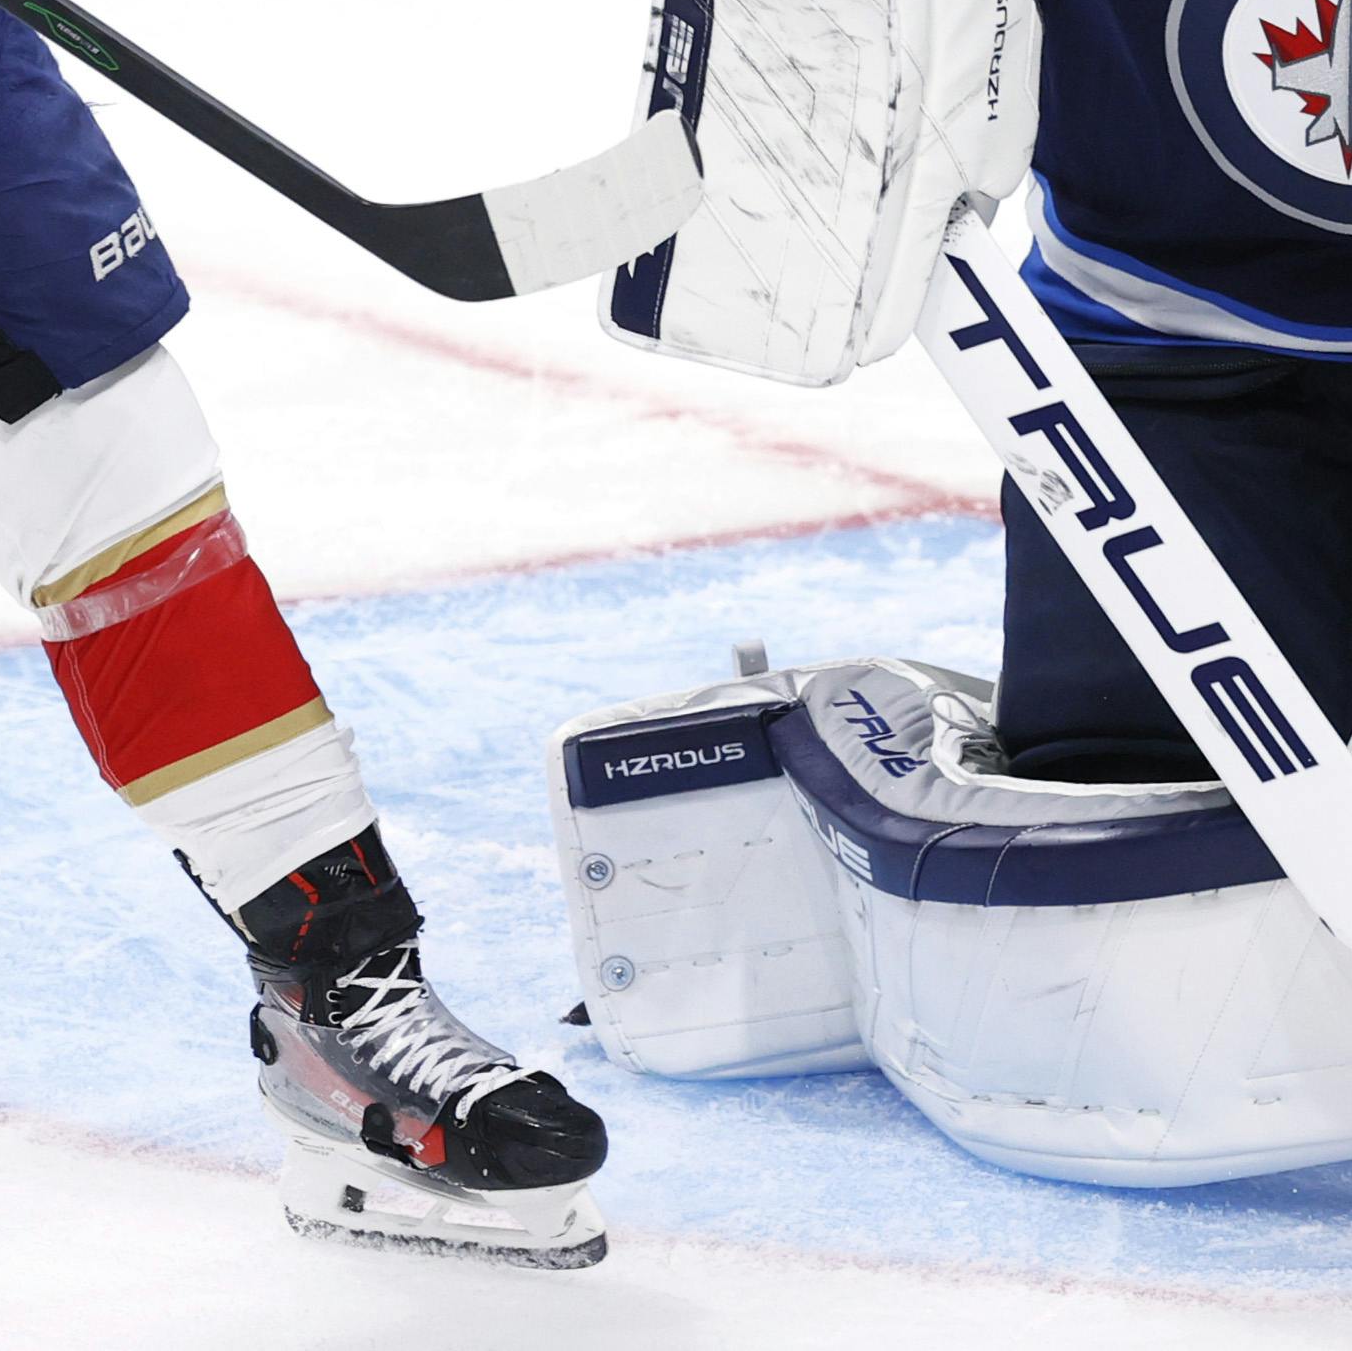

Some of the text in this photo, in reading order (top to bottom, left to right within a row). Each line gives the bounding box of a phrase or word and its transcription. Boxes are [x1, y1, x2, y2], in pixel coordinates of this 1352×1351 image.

[943, 251, 1320, 783] TRUE
[604, 741, 746, 781] HZRDUS
[832, 689, 928, 780] TRUE
